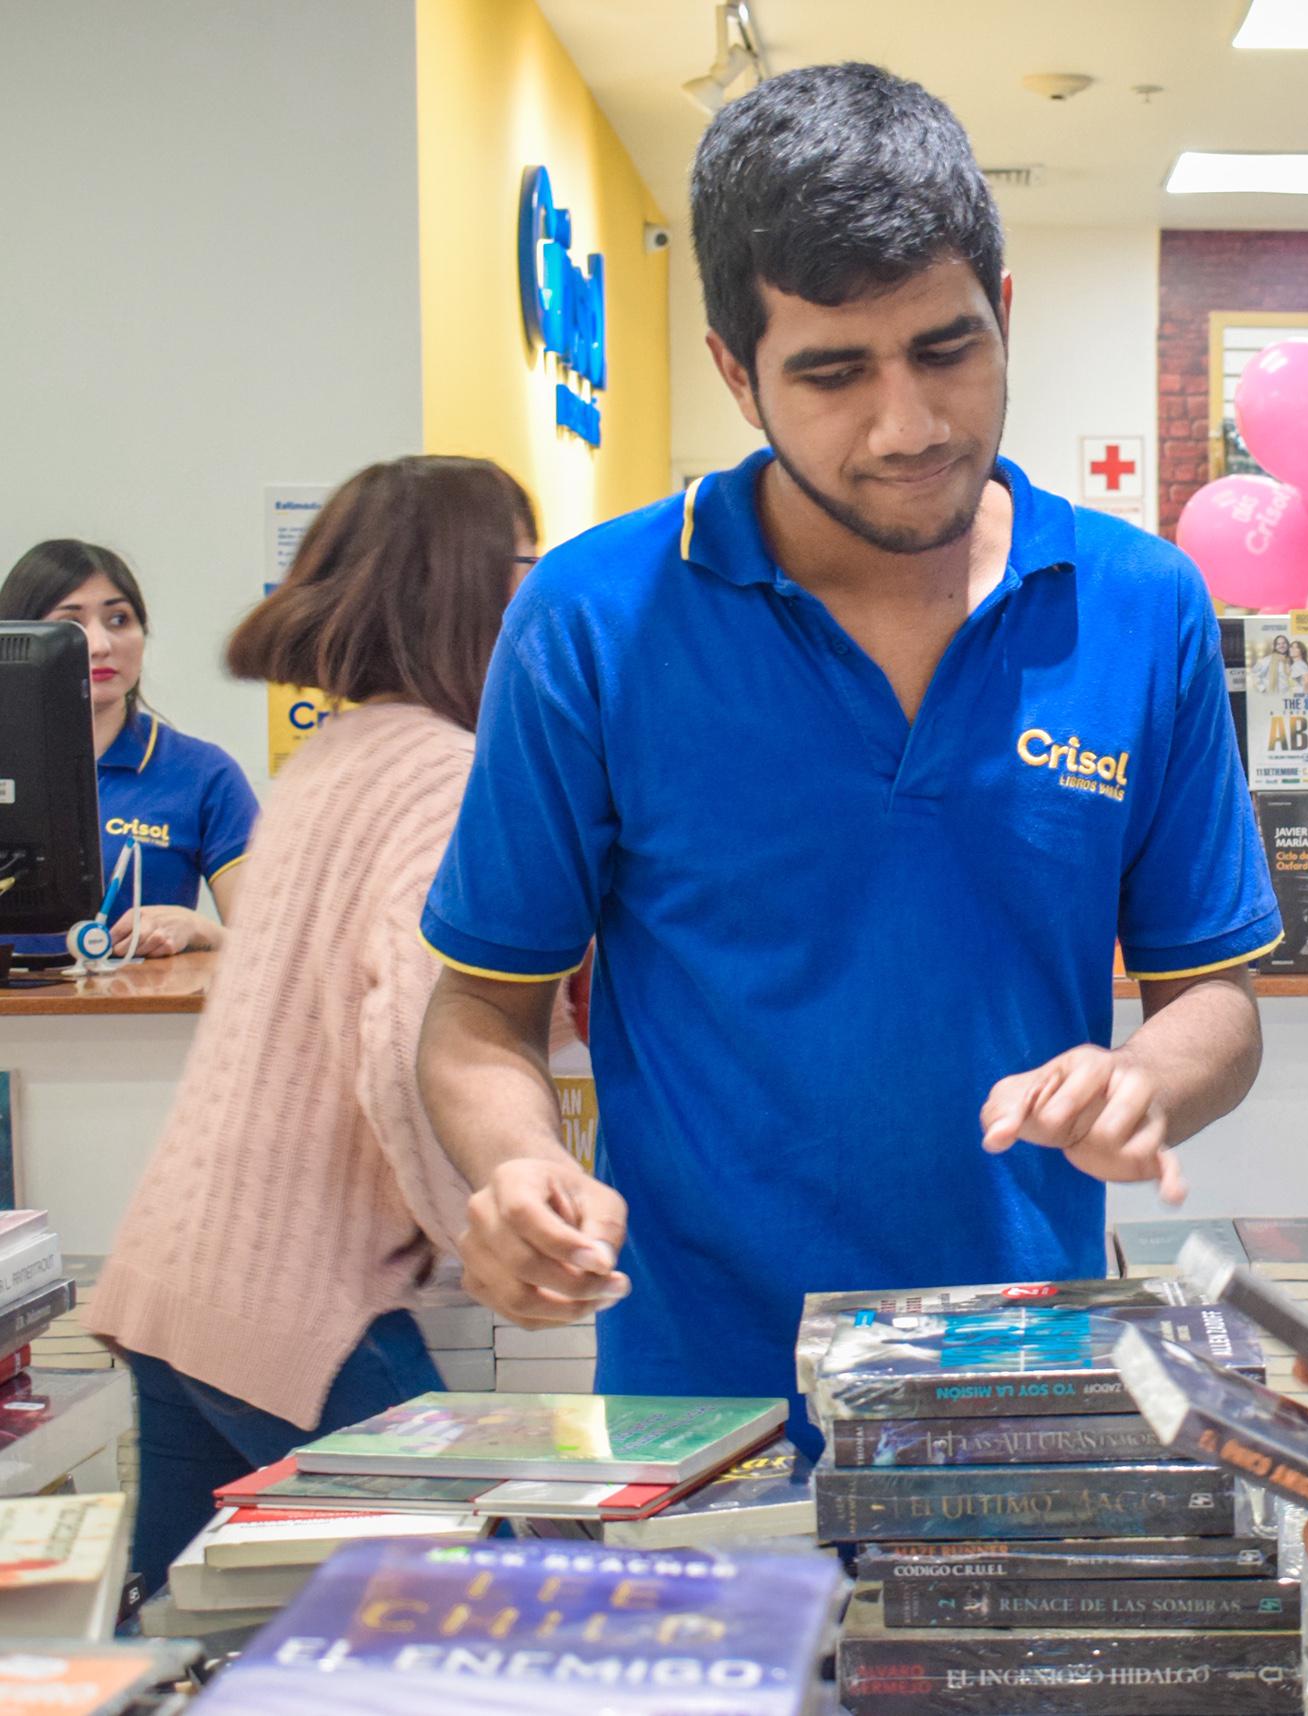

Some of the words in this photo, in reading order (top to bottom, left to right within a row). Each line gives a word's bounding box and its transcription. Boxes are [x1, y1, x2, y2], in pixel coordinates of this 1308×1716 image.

[1284, 699, 1301, 710] THE
[1016, 728, 1130, 786] Crisol
[105, 818, 170, 841] Crisol
[1275, 827, 1308, 839] JAVIER
[561, 1088, 582, 1115] AN
[936, 1385, 993, 1402] MISIÓN
[997, 1385, 1015, 1398] LA
[1018, 1384, 1049, 1397] SOY
[1052, 1383, 1076, 1397] YO
[911, 1497, 933, 1517] EL
[1000, 1597, 1073, 1612] RENACE
[1079, 1598, 1107, 1612] DE
[1112, 1598, 1147, 1612] LAS
[1151, 1598, 1242, 1613] SOMBRAS
[273, 1635, 364, 1673] EL
[394, 1642, 764, 1690] ENEMIGO
[947, 1669, 975, 1689] EL
[979, 1668, 1104, 1688] INGENIOSO
[1109, 1666, 1210, 1685] HIDALGO
